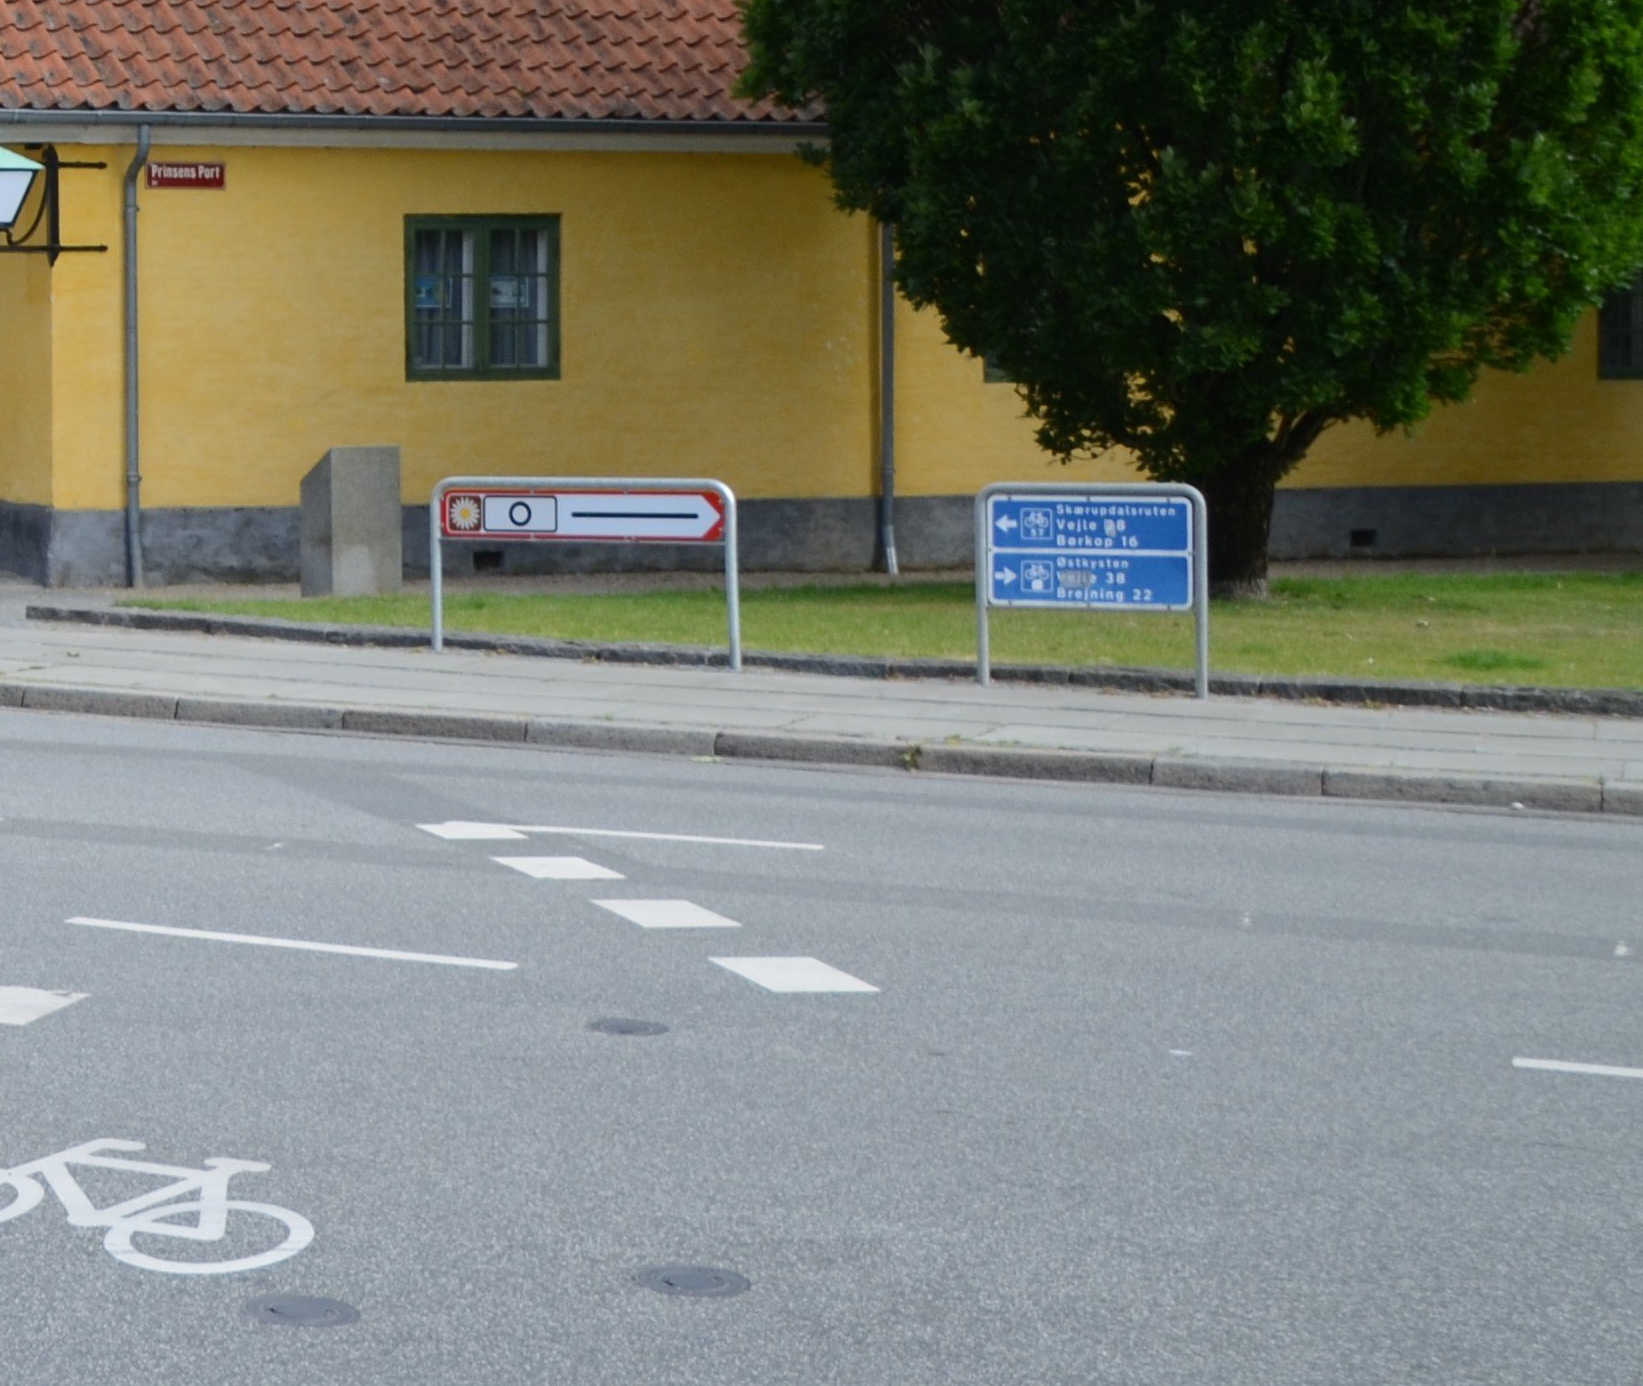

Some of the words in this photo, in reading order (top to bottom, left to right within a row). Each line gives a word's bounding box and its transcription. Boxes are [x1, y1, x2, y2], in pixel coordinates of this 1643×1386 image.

[151, 164, 196, 179] Prinsens
[198, 165, 220, 179] Port
[1056, 503, 1176, 516] Skærupdalsruten
[1057, 519, 1097, 532] Vejle
[1121, 535, 1139, 547] 16
[1056, 556, 1129, 569] Østkysten
[1105, 572, 1126, 584] 38
[1056, 587, 1124, 602] Brejning
[1132, 588, 1152, 601] 22
